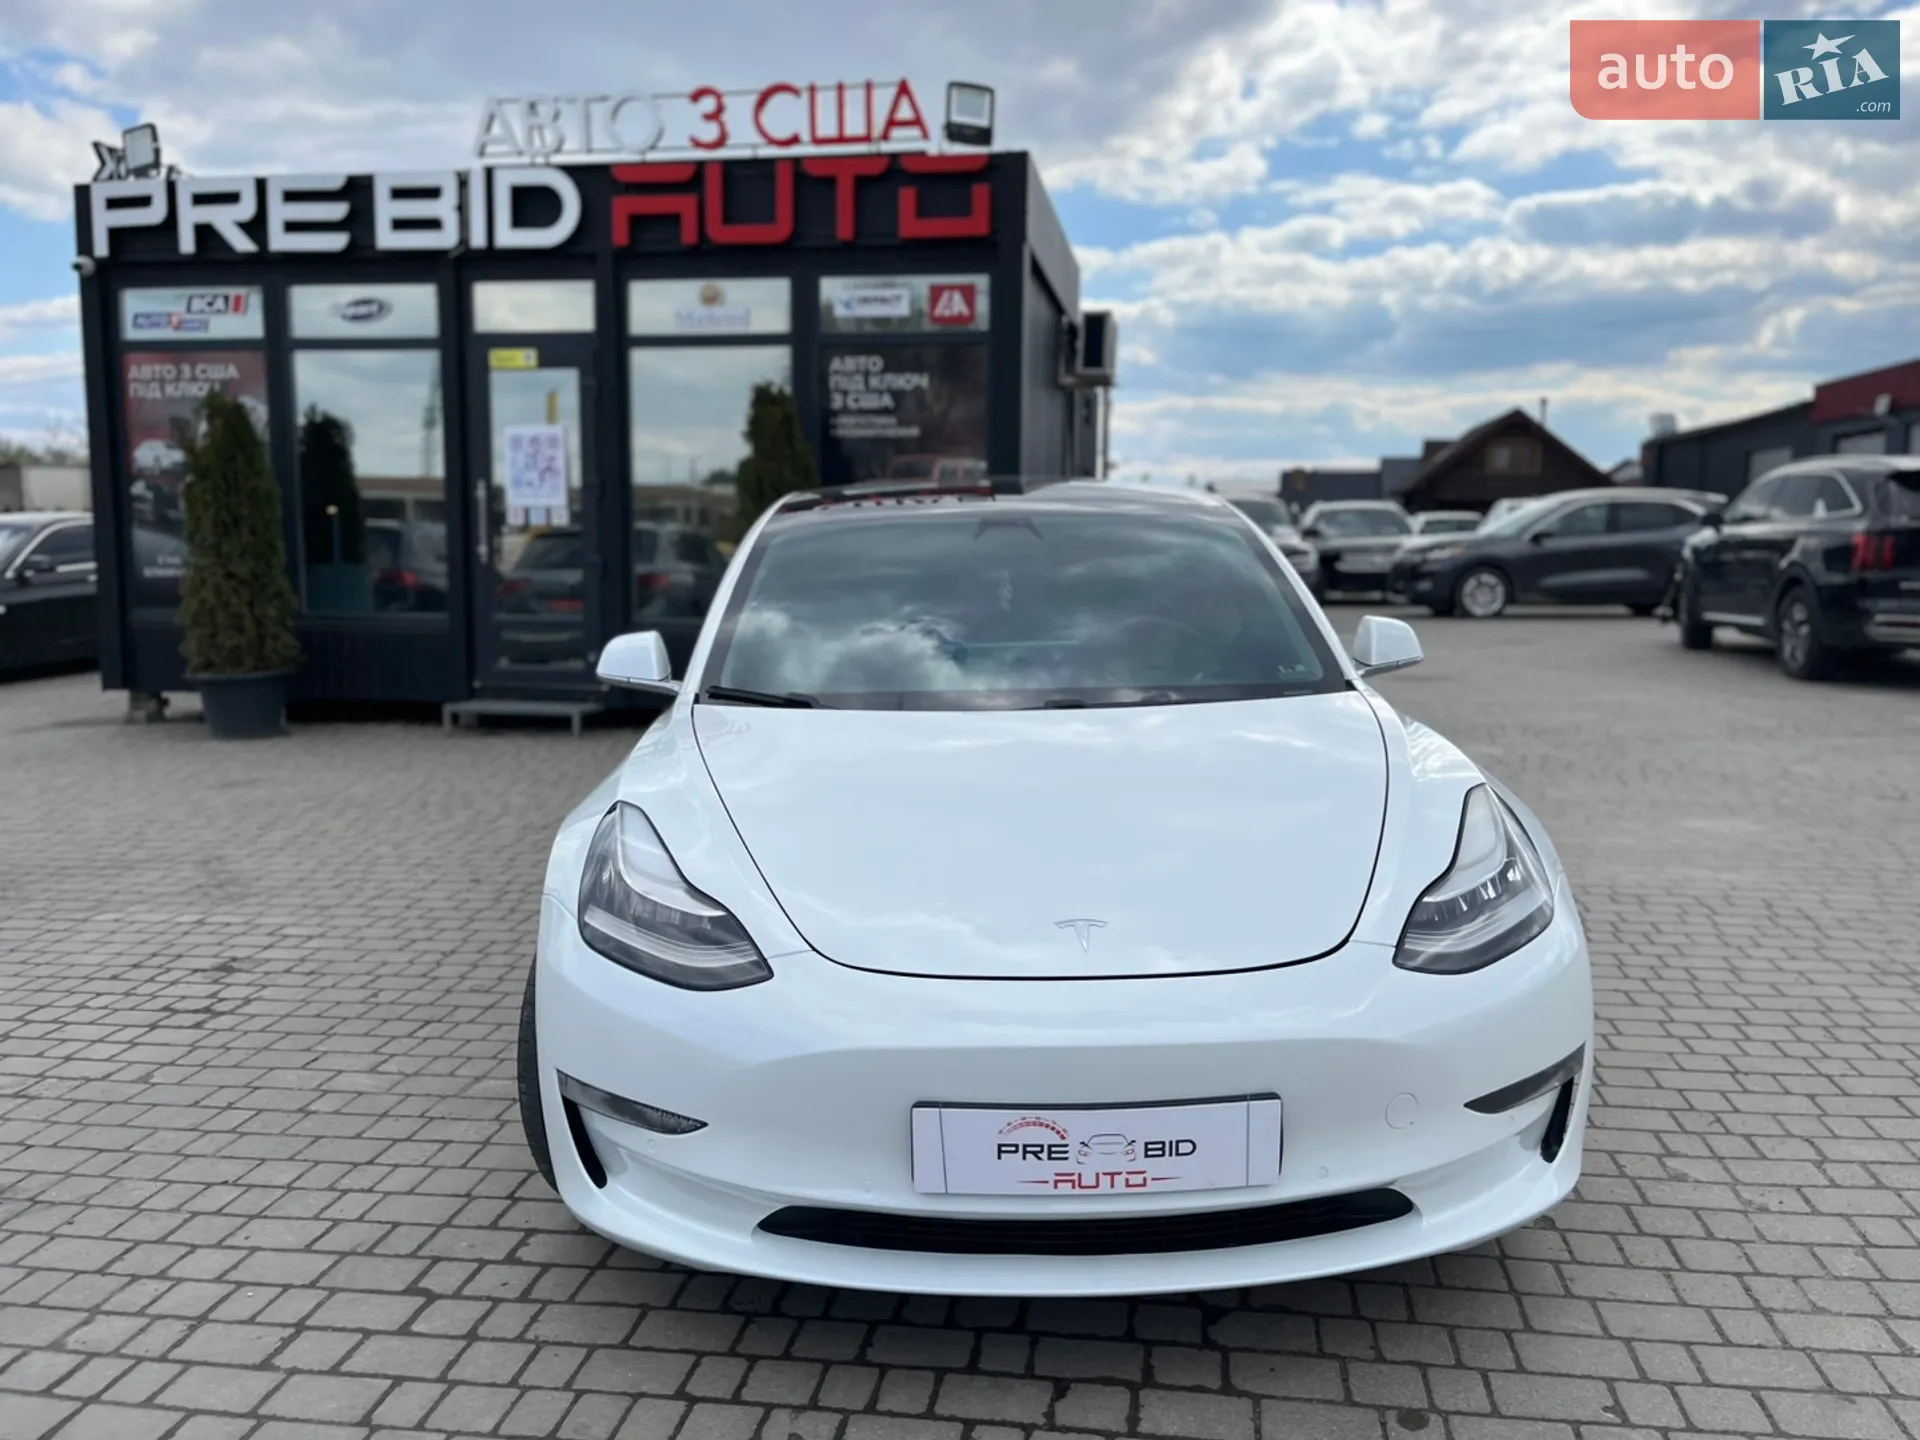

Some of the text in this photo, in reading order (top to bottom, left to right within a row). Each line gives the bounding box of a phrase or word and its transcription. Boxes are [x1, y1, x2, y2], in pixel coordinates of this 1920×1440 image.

[476, 93, 665, 157] АВТО
[753, 77, 931, 148] США
[91, 152, 991, 257] PRE BID AUTO
[128, 363, 178, 381] АВТО
[195, 362, 240, 380] США
[829, 354, 885, 373] АВТО
[846, 391, 896, 410] США
[997, 1138, 1197, 1161] PRE BID
[1053, 1170, 1148, 1190] AUTO
